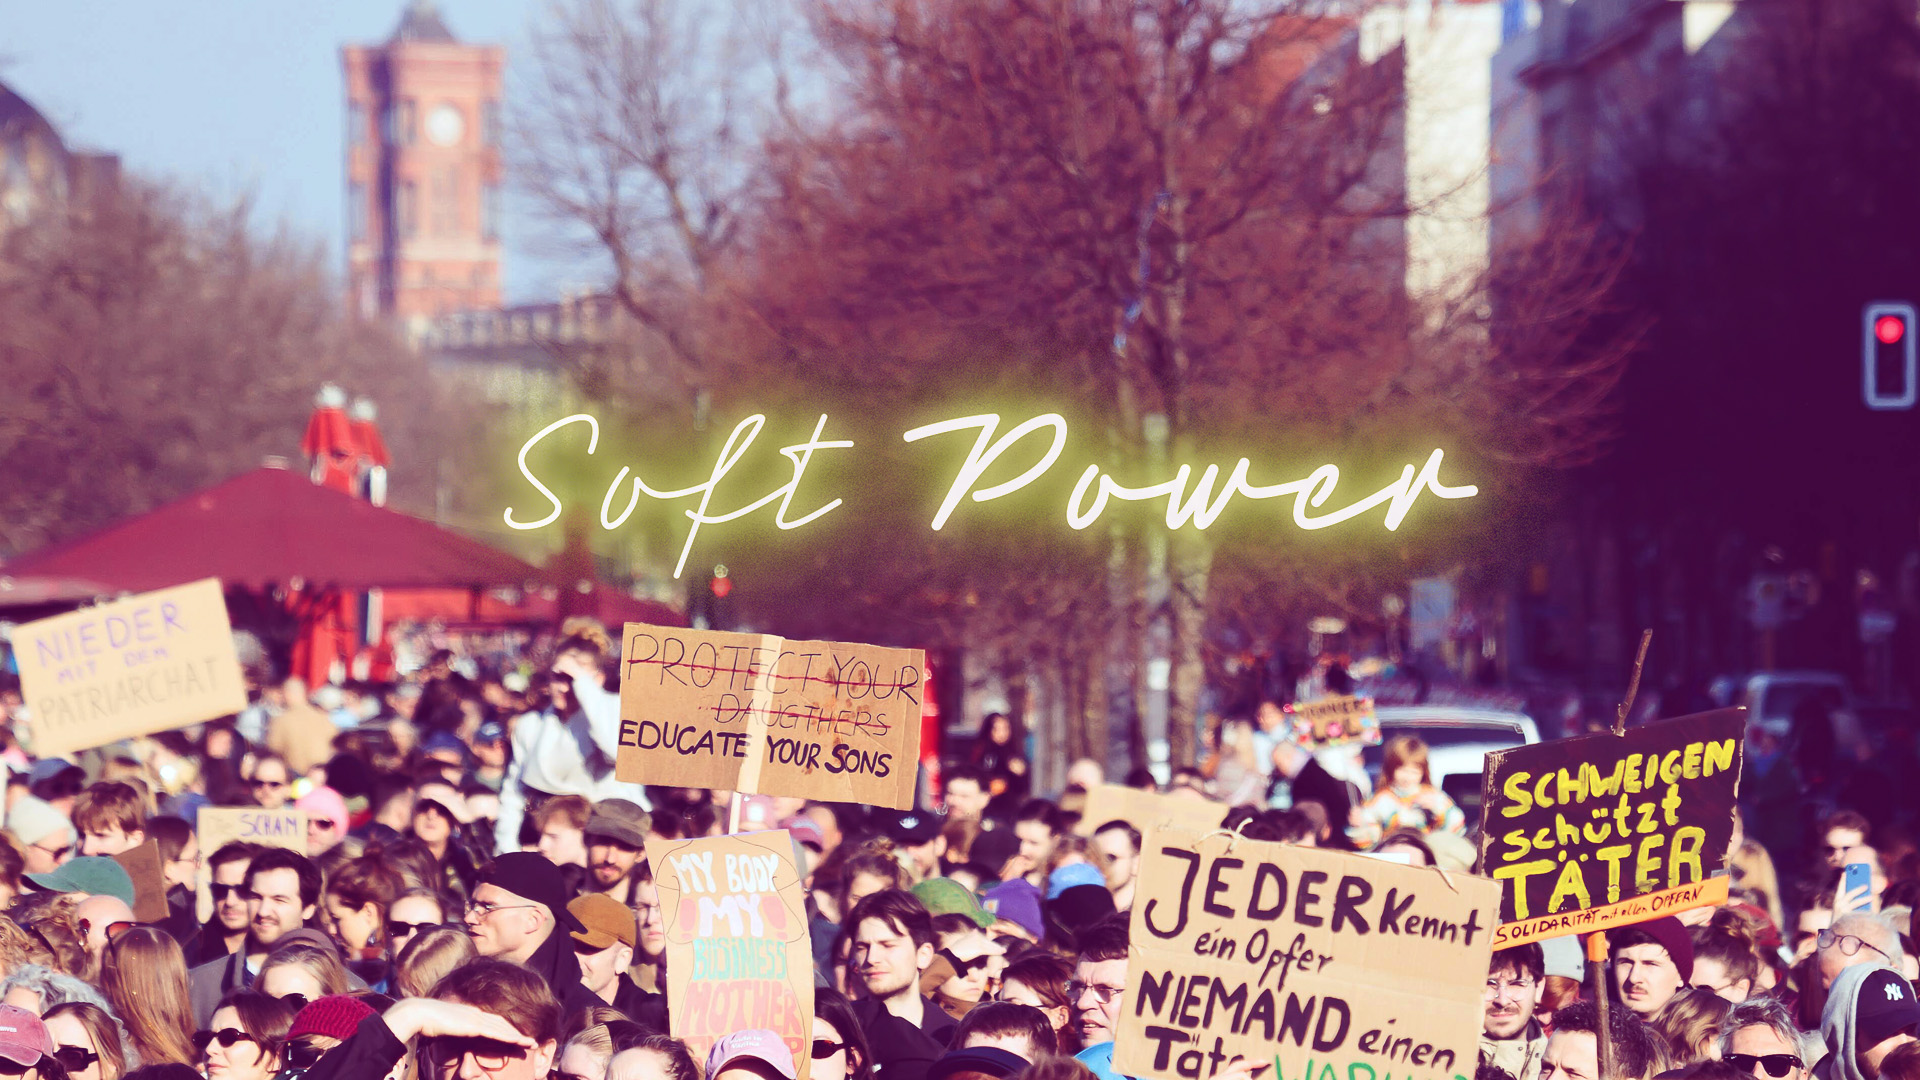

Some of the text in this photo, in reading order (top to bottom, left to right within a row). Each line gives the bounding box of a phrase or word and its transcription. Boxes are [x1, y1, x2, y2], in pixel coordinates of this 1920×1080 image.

[35, 602, 187, 667] NIEDER
[57, 646, 169, 685] MIT DEM
[38, 656, 218, 729] PATRIARCHAT
[628, 633, 919, 705] PROTECT YOUR
[714, 694, 889, 736] DAUGTHERS
[618, 720, 892, 778] EDUCATE YOUR SONS
[1501, 739, 1736, 818] SCHWEIGEN
[240, 814, 298, 837] SCHAM
[1502, 783, 1682, 862] schützt
[669, 851, 779, 894] MY BODY
[1144, 847, 1484, 946] JEDER Kennt
[1493, 826, 1706, 921] TÄTER
[1493, 909, 1600, 945] SOLIDARITÄT
[1601, 907, 1618, 921] mit
[1194, 926, 1335, 992] ein Opfer
[678, 979, 803, 1036] MOTHER
[1136, 970, 1456, 1073] NIEMAND einen
[1145, 1025, 1272, 1080] Tät
